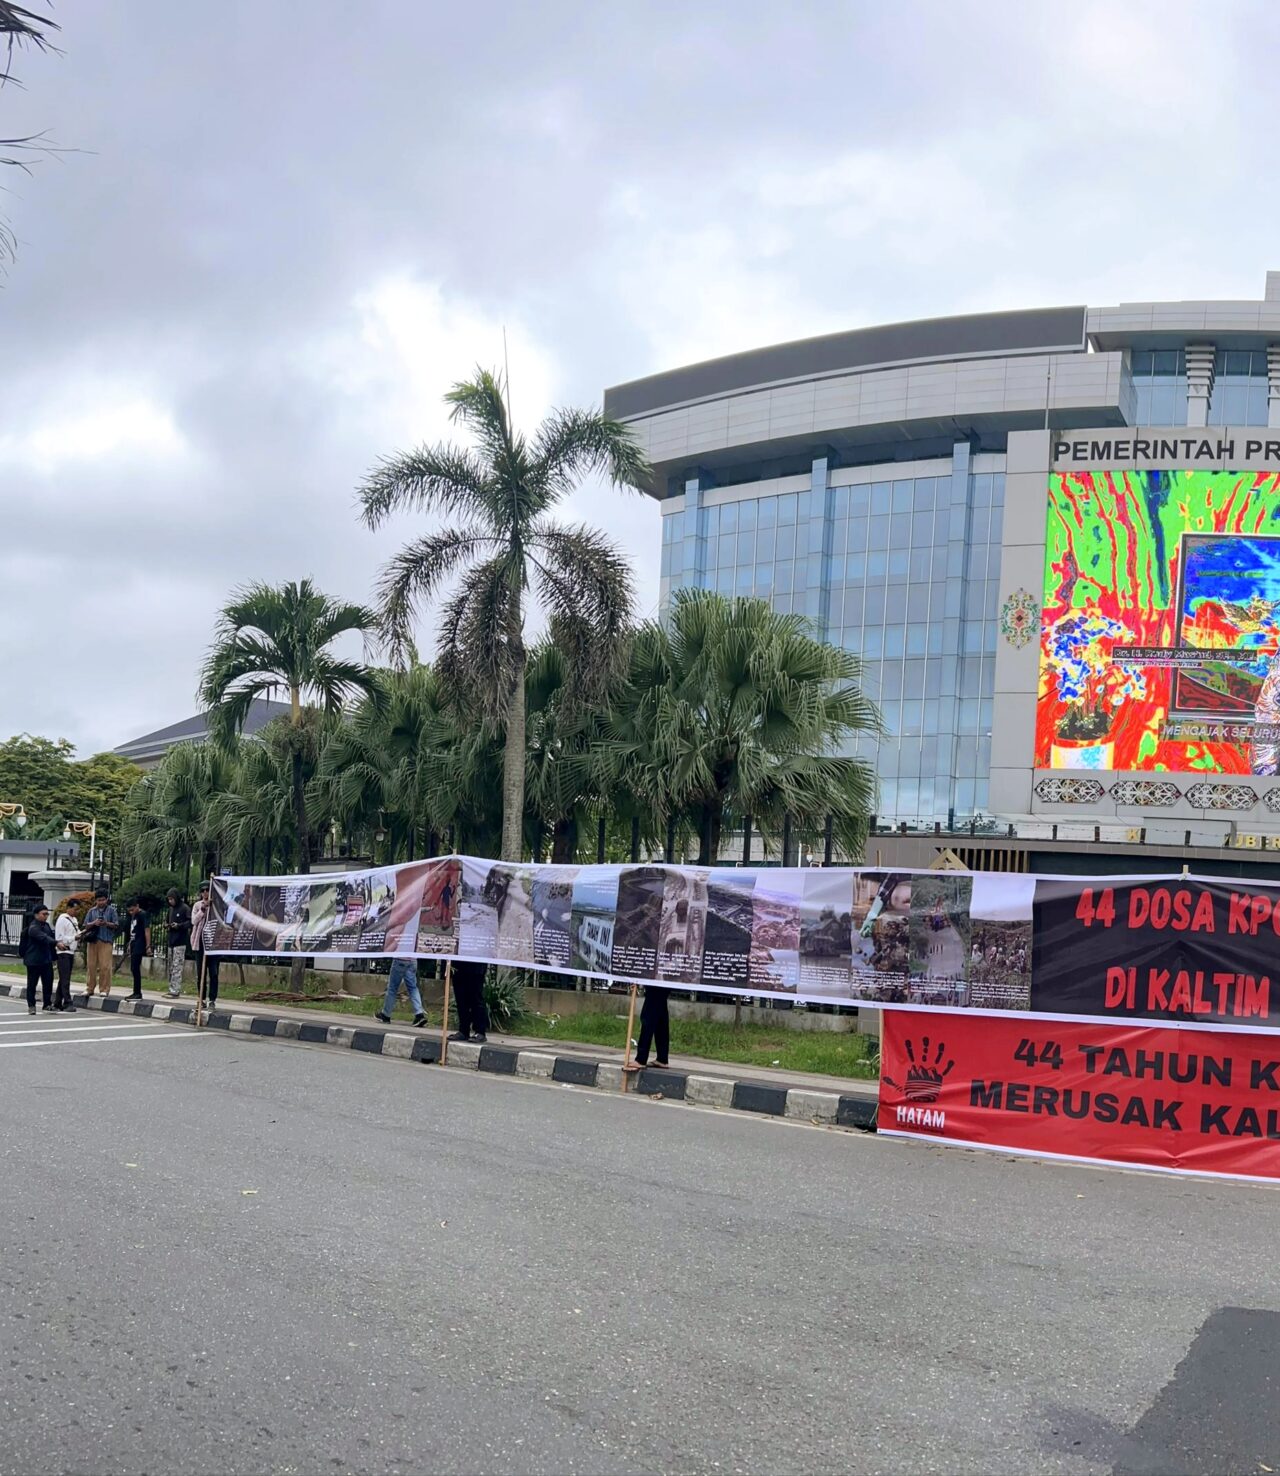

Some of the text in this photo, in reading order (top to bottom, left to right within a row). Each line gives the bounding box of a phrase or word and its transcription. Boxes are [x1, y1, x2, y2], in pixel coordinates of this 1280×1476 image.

[1053, 439, 1234, 462] PEMERINTAH
[1162, 725, 1229, 737] MENGAJAK
[1075, 888, 1116, 928] 44
[1128, 888, 1216, 933] DOSA
[1104, 966, 1270, 1019] DI KALTIM
[1013, 1038, 1064, 1070] 44
[1078, 1044, 1233, 1087] TAHUN
[896, 1105, 945, 1129] HATAM
[969, 1079, 1184, 1131] MERUSAK
